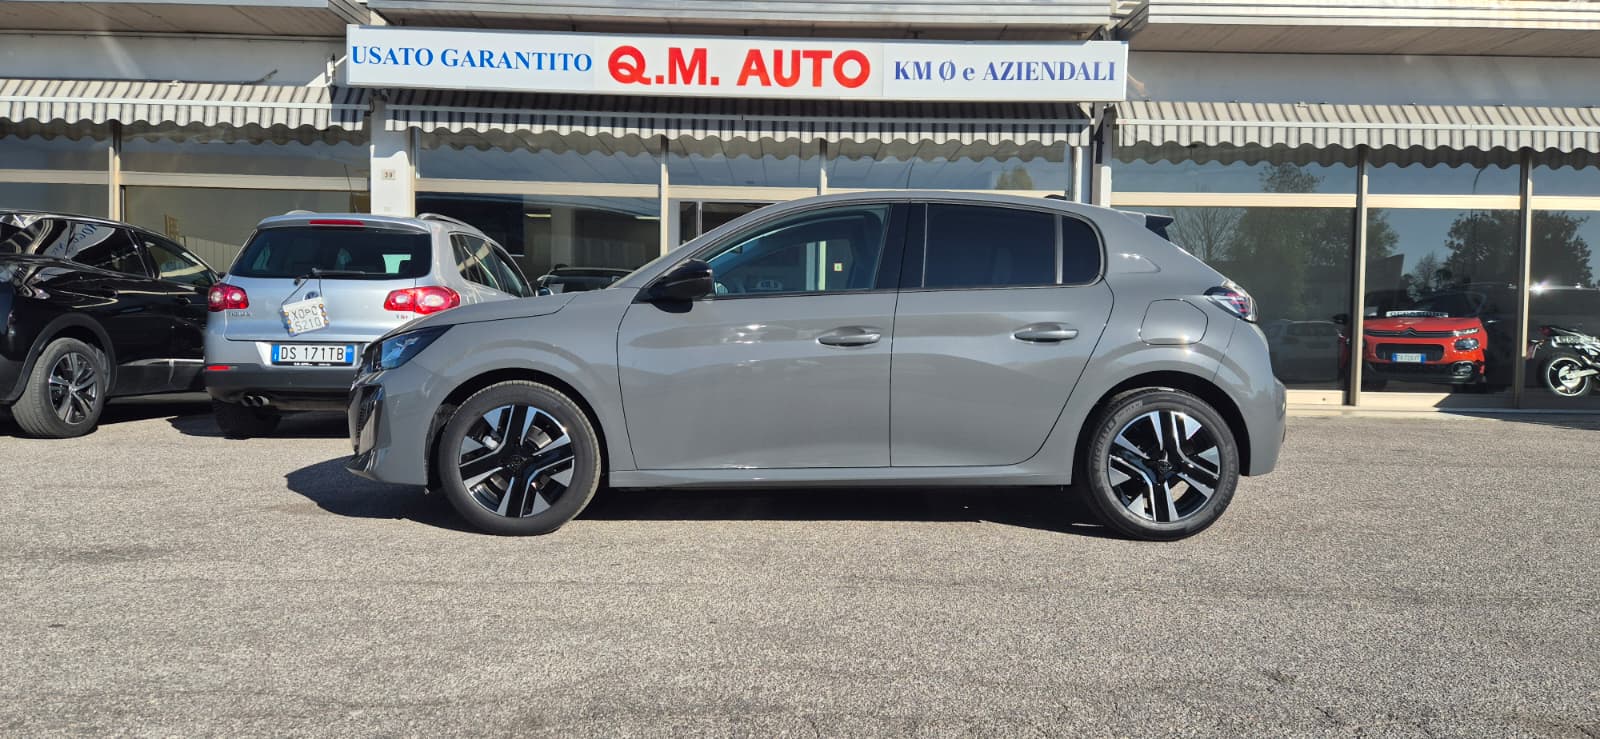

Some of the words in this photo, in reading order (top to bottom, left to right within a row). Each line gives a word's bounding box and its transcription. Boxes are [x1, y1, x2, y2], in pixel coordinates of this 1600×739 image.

[351, 45, 434, 67] USATO
[440, 48, 593, 72] GARANTITO
[607, 45, 720, 86] Q.M.
[736, 48, 871, 88] AUTO
[894, 60, 932, 81] KM
[962, 67, 976, 81] e
[982, 61, 1116, 82] AZIENDALI
[281, 346, 297, 361] DS
